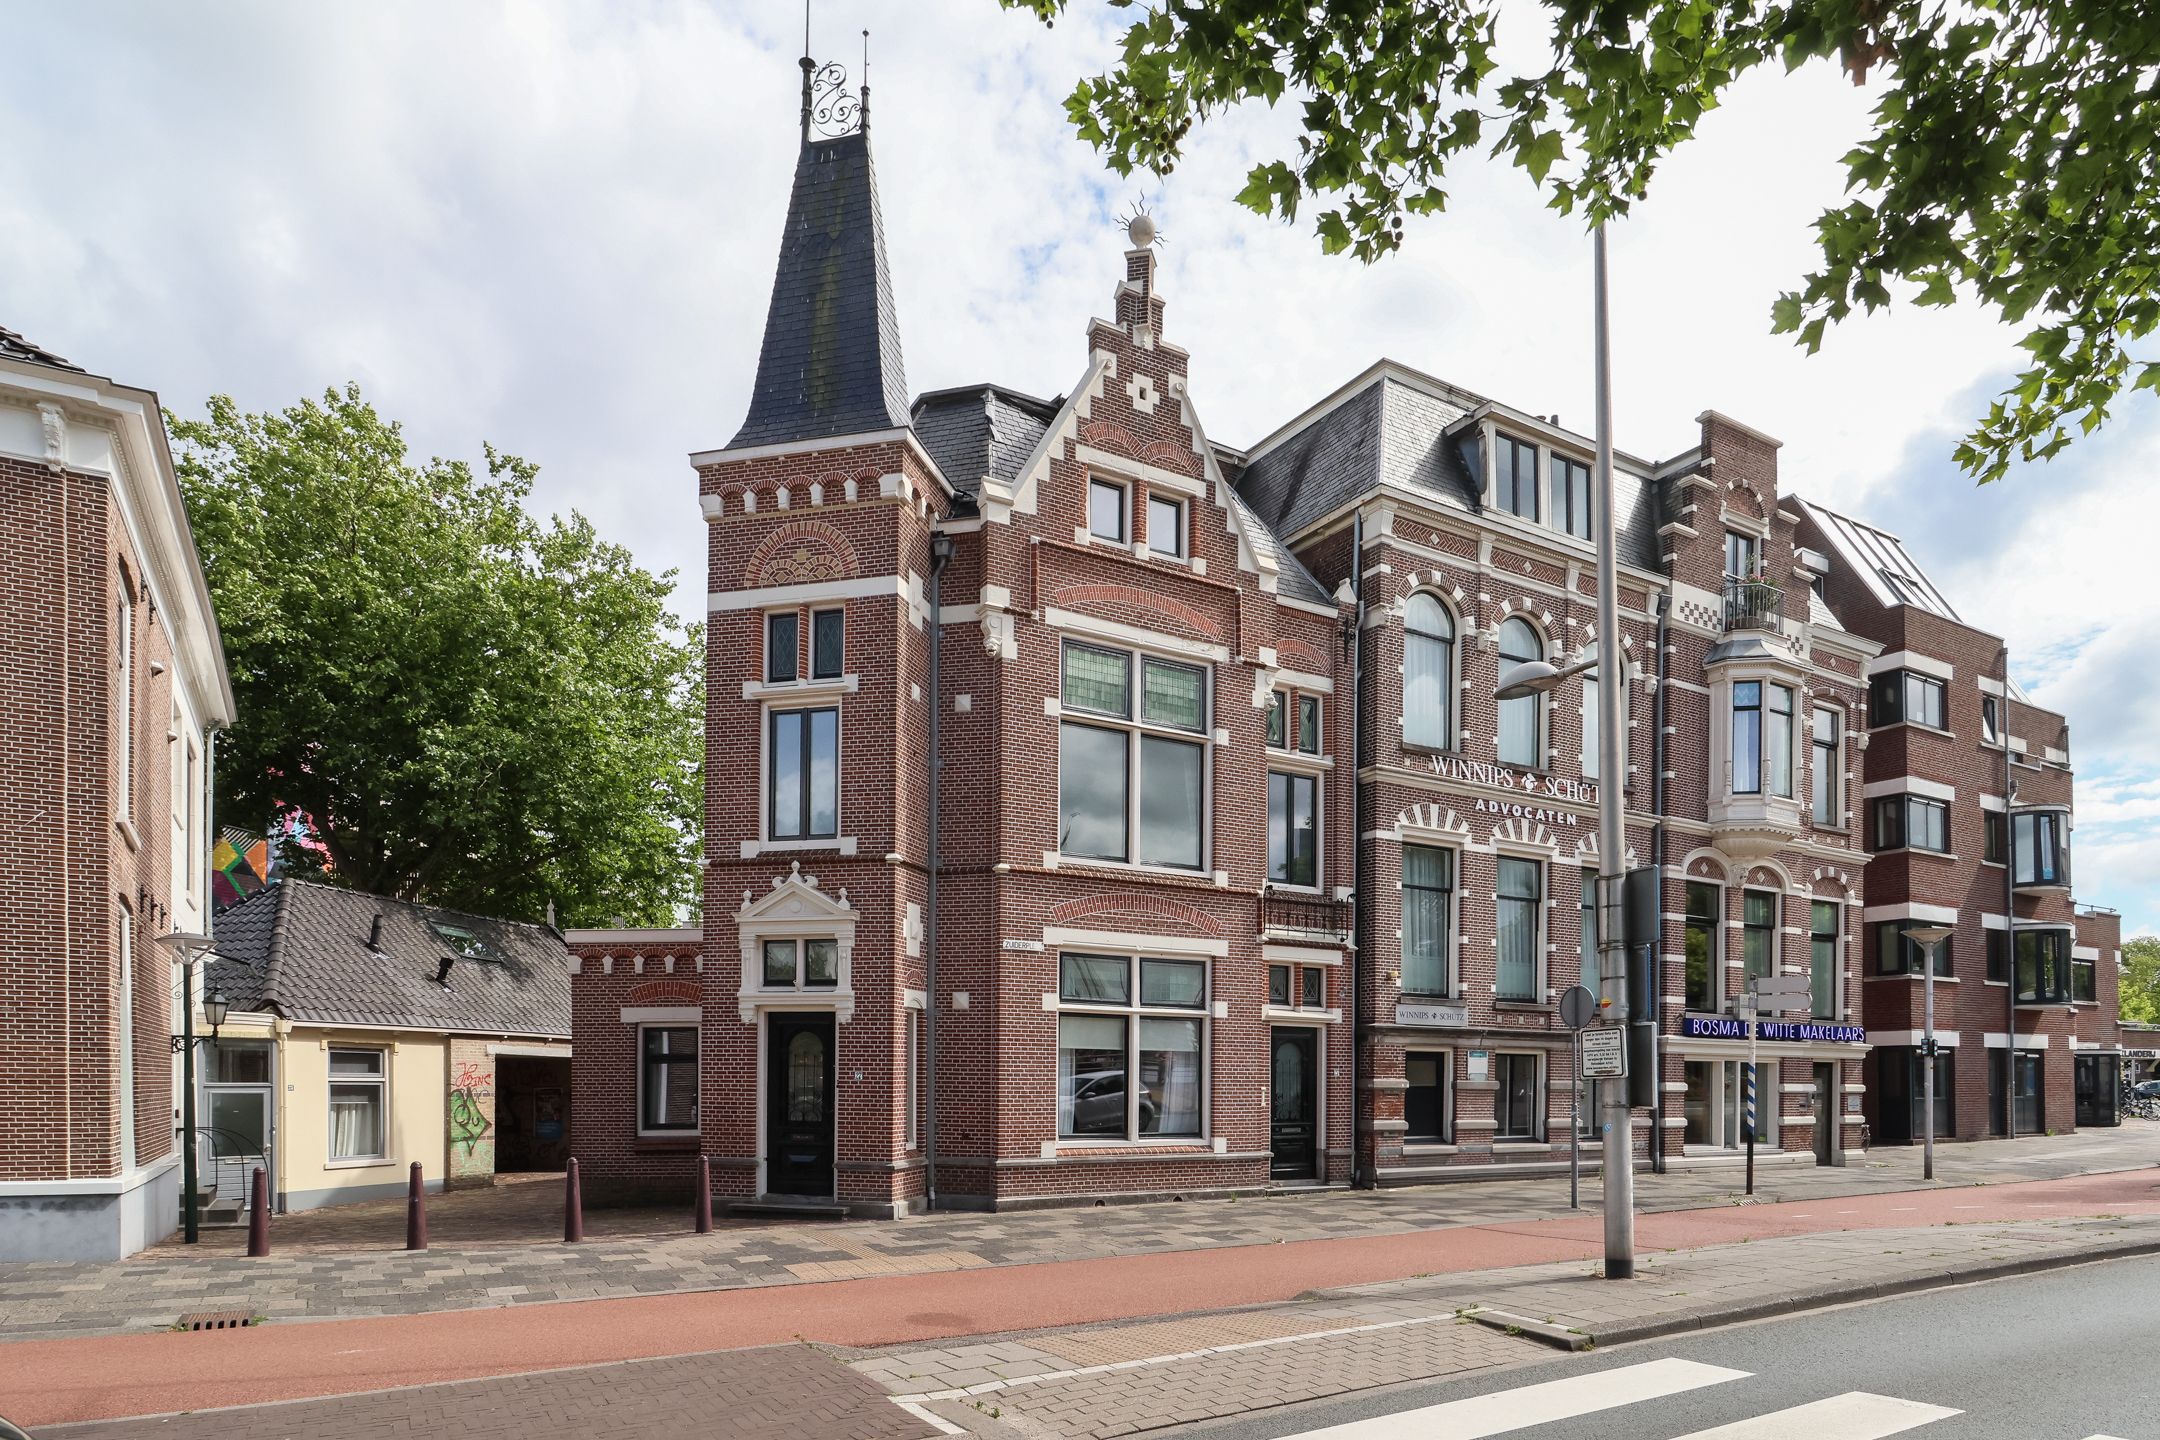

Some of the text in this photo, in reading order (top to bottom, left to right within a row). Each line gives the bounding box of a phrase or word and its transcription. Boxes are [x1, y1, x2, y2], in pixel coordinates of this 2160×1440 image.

[1431, 754, 1600, 804] WINNIPS SCHÜT
[1475, 798, 1577, 827] ADVOCATEN
[1399, 1010, 1429, 1019] WINNIPS
[1693, 1018, 1740, 1036] BOSMA
[1763, 1022, 1795, 1039] WITTE
[1800, 1024, 1865, 1042] MAKELAARS
